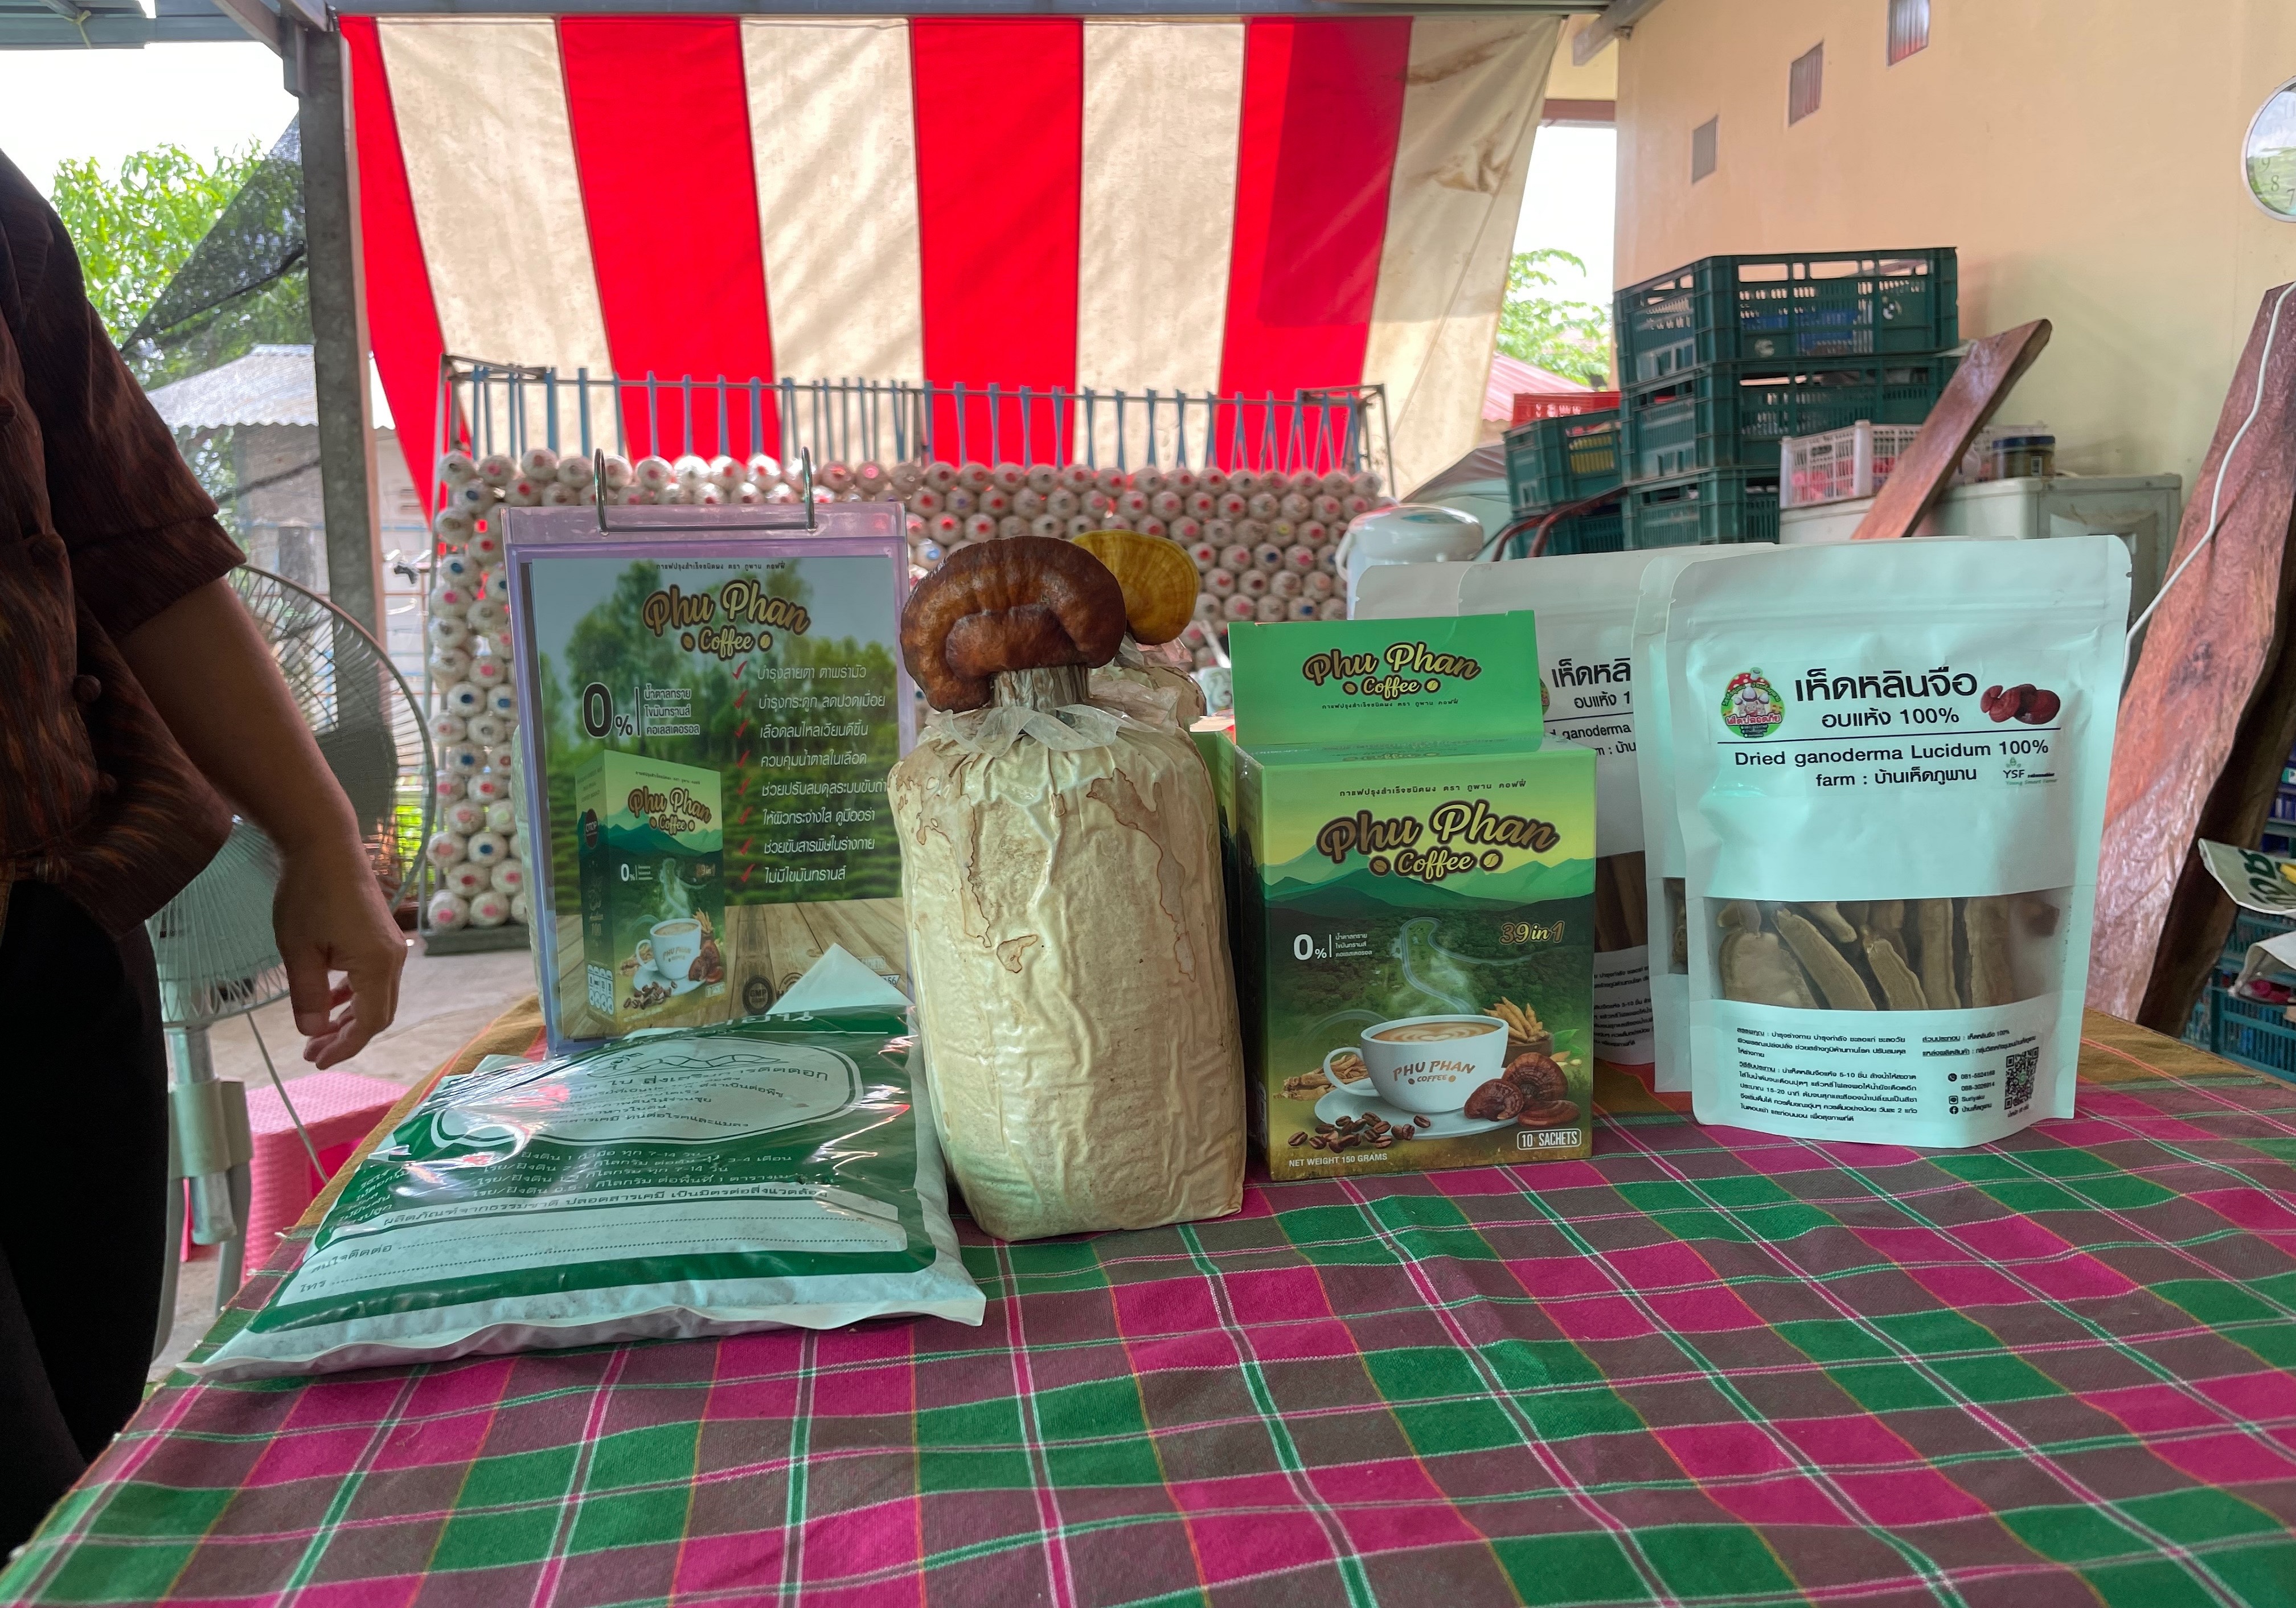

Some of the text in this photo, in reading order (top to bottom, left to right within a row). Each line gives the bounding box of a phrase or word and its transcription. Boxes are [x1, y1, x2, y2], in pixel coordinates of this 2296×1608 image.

[643, 580, 811, 636] Phu Phan
[699, 626, 755, 661] Coffee
[757, 664, 867, 683] บำรุงสายตา ตาพร่ามัว
[1303, 641, 1482, 686] Phu Phan
[1551, 657, 1631, 688] เห็ดหลิ
[643, 683, 691, 700] น้ำตาลทราย
[1361, 674, 1421, 700] Coffee
[1795, 666, 1978, 702] เห็ดหลินจือ
[759, 690, 885, 712] บำรุงกระดูก ลดปวดเมื่อย
[1574, 691, 1617, 708] อบแห้ง
[644, 704, 691, 717] ไขมันทรานส์
[1822, 707, 1959, 728] อบแห้ง 100%
[646, 724, 700, 735] คอเลสเตอรอล
[760, 719, 868, 738] เลือดลมไหลเวียนดีขึ้น
[761, 749, 867, 770] ควบคุมน้ำตาลในเลือด
[1735, 739, 2049, 768] Dried ganoderma Lucidum 100%
[1815, 774, 1855, 787] farm
[1874, 766, 1977, 785] บ้านเห็ดภูพาน
[2003, 769, 2025, 779] YSF
[762, 778, 887, 798] ช่วยปรับสมดุลระบบขับถ่า
[1339, 786, 1436, 797] กาแฟปรุงสำเร็จชนิดผง
[1467, 783, 1492, 793] ภูพาน
[1499, 778, 1527, 789] คอฟฟี่
[628, 786, 711, 824] Phu Phan
[658, 814, 687, 835] Coffee
[763, 807, 875, 826] ให้ผิวกระจ่างใส ดูมีออร่า
[1316, 799, 1560, 863] Phu Phan
[764, 835, 875, 854] ช่วยขับสารพิษในร่างกาย
[765, 865, 846, 883] ไม่มีไขมันทรานส์
[1394, 846, 1478, 884] Coffee
[1737, 1027, 1765, 1037] สรรพคุณ
[1772, 1031, 1811, 1040] บำรุงร่างกาย
[1814, 1034, 1847, 1043] บำรุงกำลัง
[1392, 1060, 1476, 1081] PHU PHAN
[1740, 1082, 1764, 1092] ประมาณ
[1522, 1131, 1577, 1147] 10 SACHETS
[1289, 1153, 1388, 1167] NET WEIGHT 150 GRAMS
[595, 1178, 651, 1188] กิโลกรัม
[658, 1174, 715, 1183] ต่อพื้นที่
[383, 1199, 559, 1226] ผลิตภัณฑ์จากธรรมชาติ
[565, 1191, 665, 1206] ปลอดสารเคมี
[671, 1185, 827, 1199] เป็นมิตรต่อสิ่งแวดล้อม
[311, 1244, 392, 1274] สนใจติดต่อ
[300, 1279, 327, 1293] โทร
